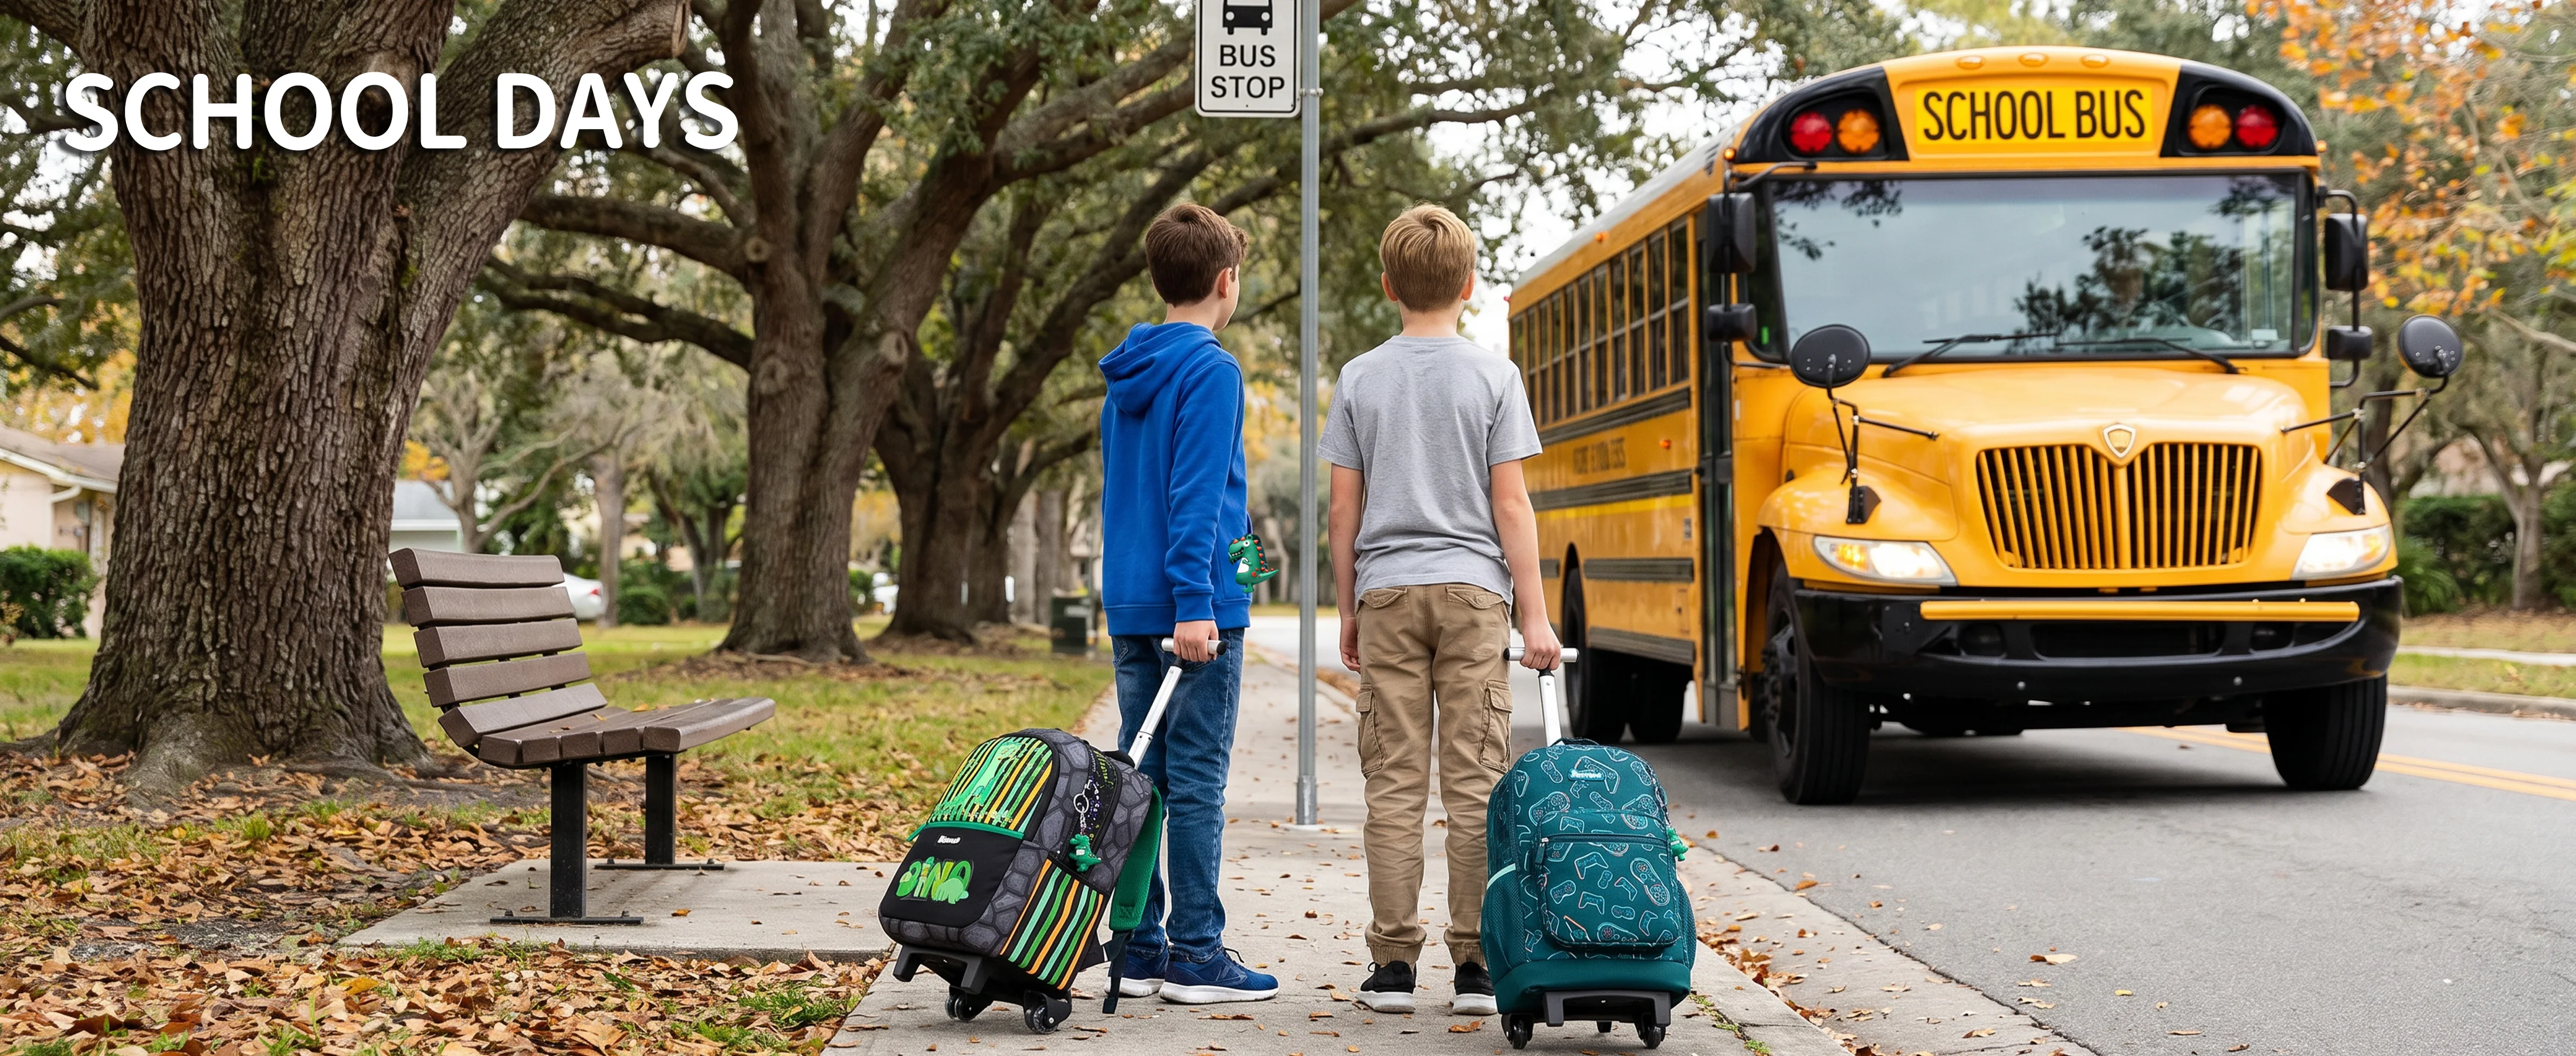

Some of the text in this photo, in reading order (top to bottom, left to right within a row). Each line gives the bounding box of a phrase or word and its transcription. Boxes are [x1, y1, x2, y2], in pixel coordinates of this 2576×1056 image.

[1220, 45, 1276, 67] BUS
[1211, 76, 1285, 99] STOP
[1923, 90, 2145, 140] SCHOOL BUS
